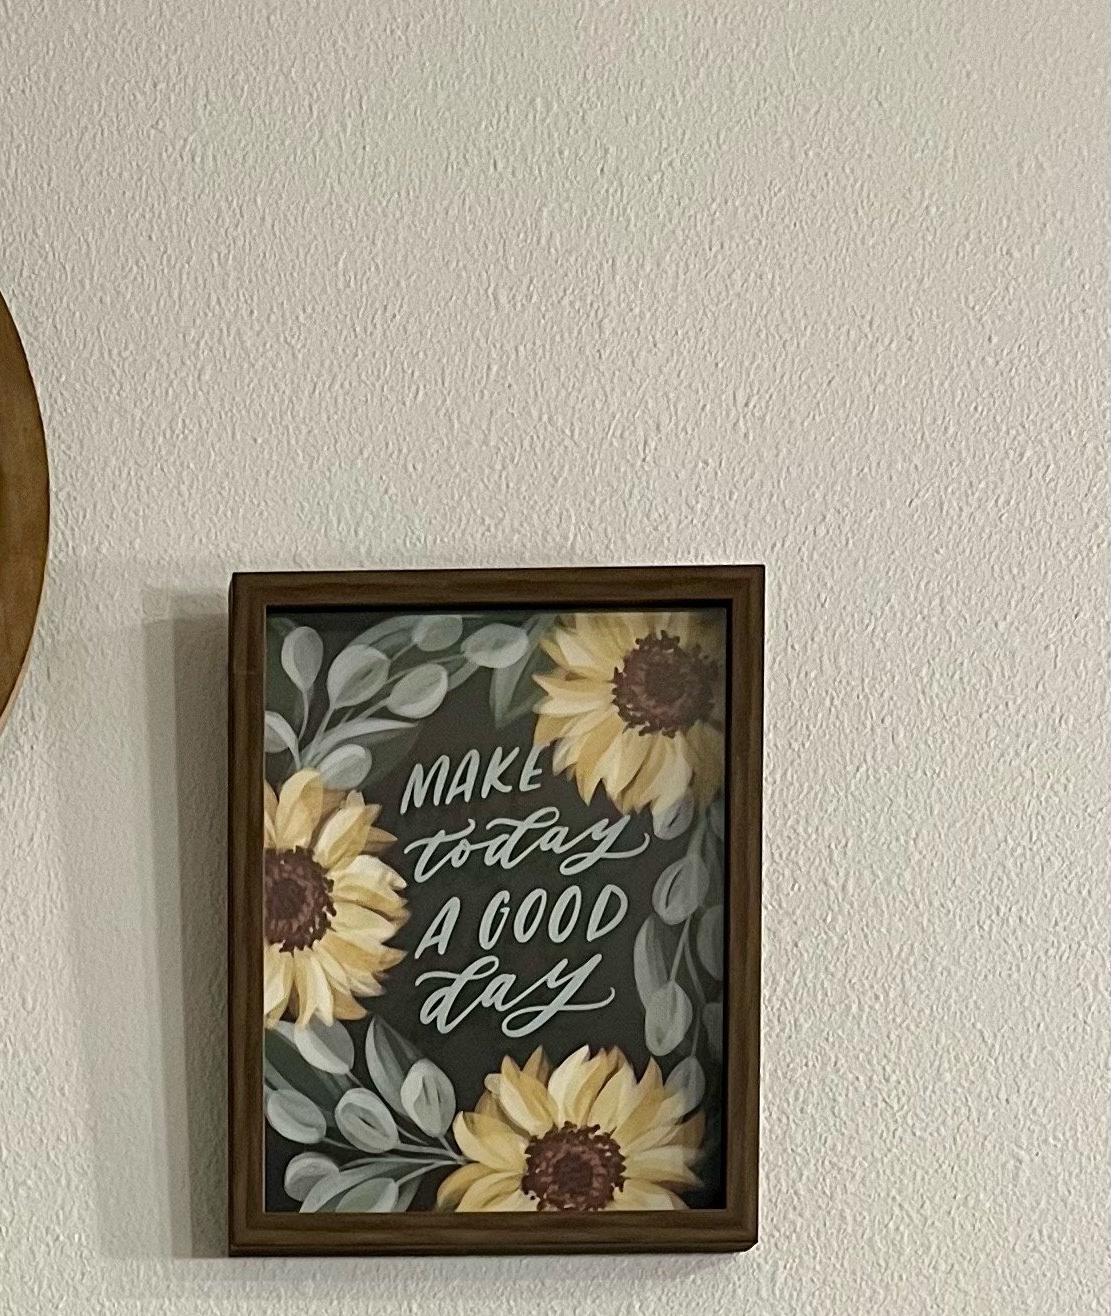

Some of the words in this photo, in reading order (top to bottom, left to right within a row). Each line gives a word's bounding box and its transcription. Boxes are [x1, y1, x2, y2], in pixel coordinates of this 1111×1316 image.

[399, 745, 550, 814] MAKE
[404, 806, 650, 883] today
[415, 896, 461, 959] A
[478, 884, 629, 952] GOOD
[415, 952, 615, 1038] day
